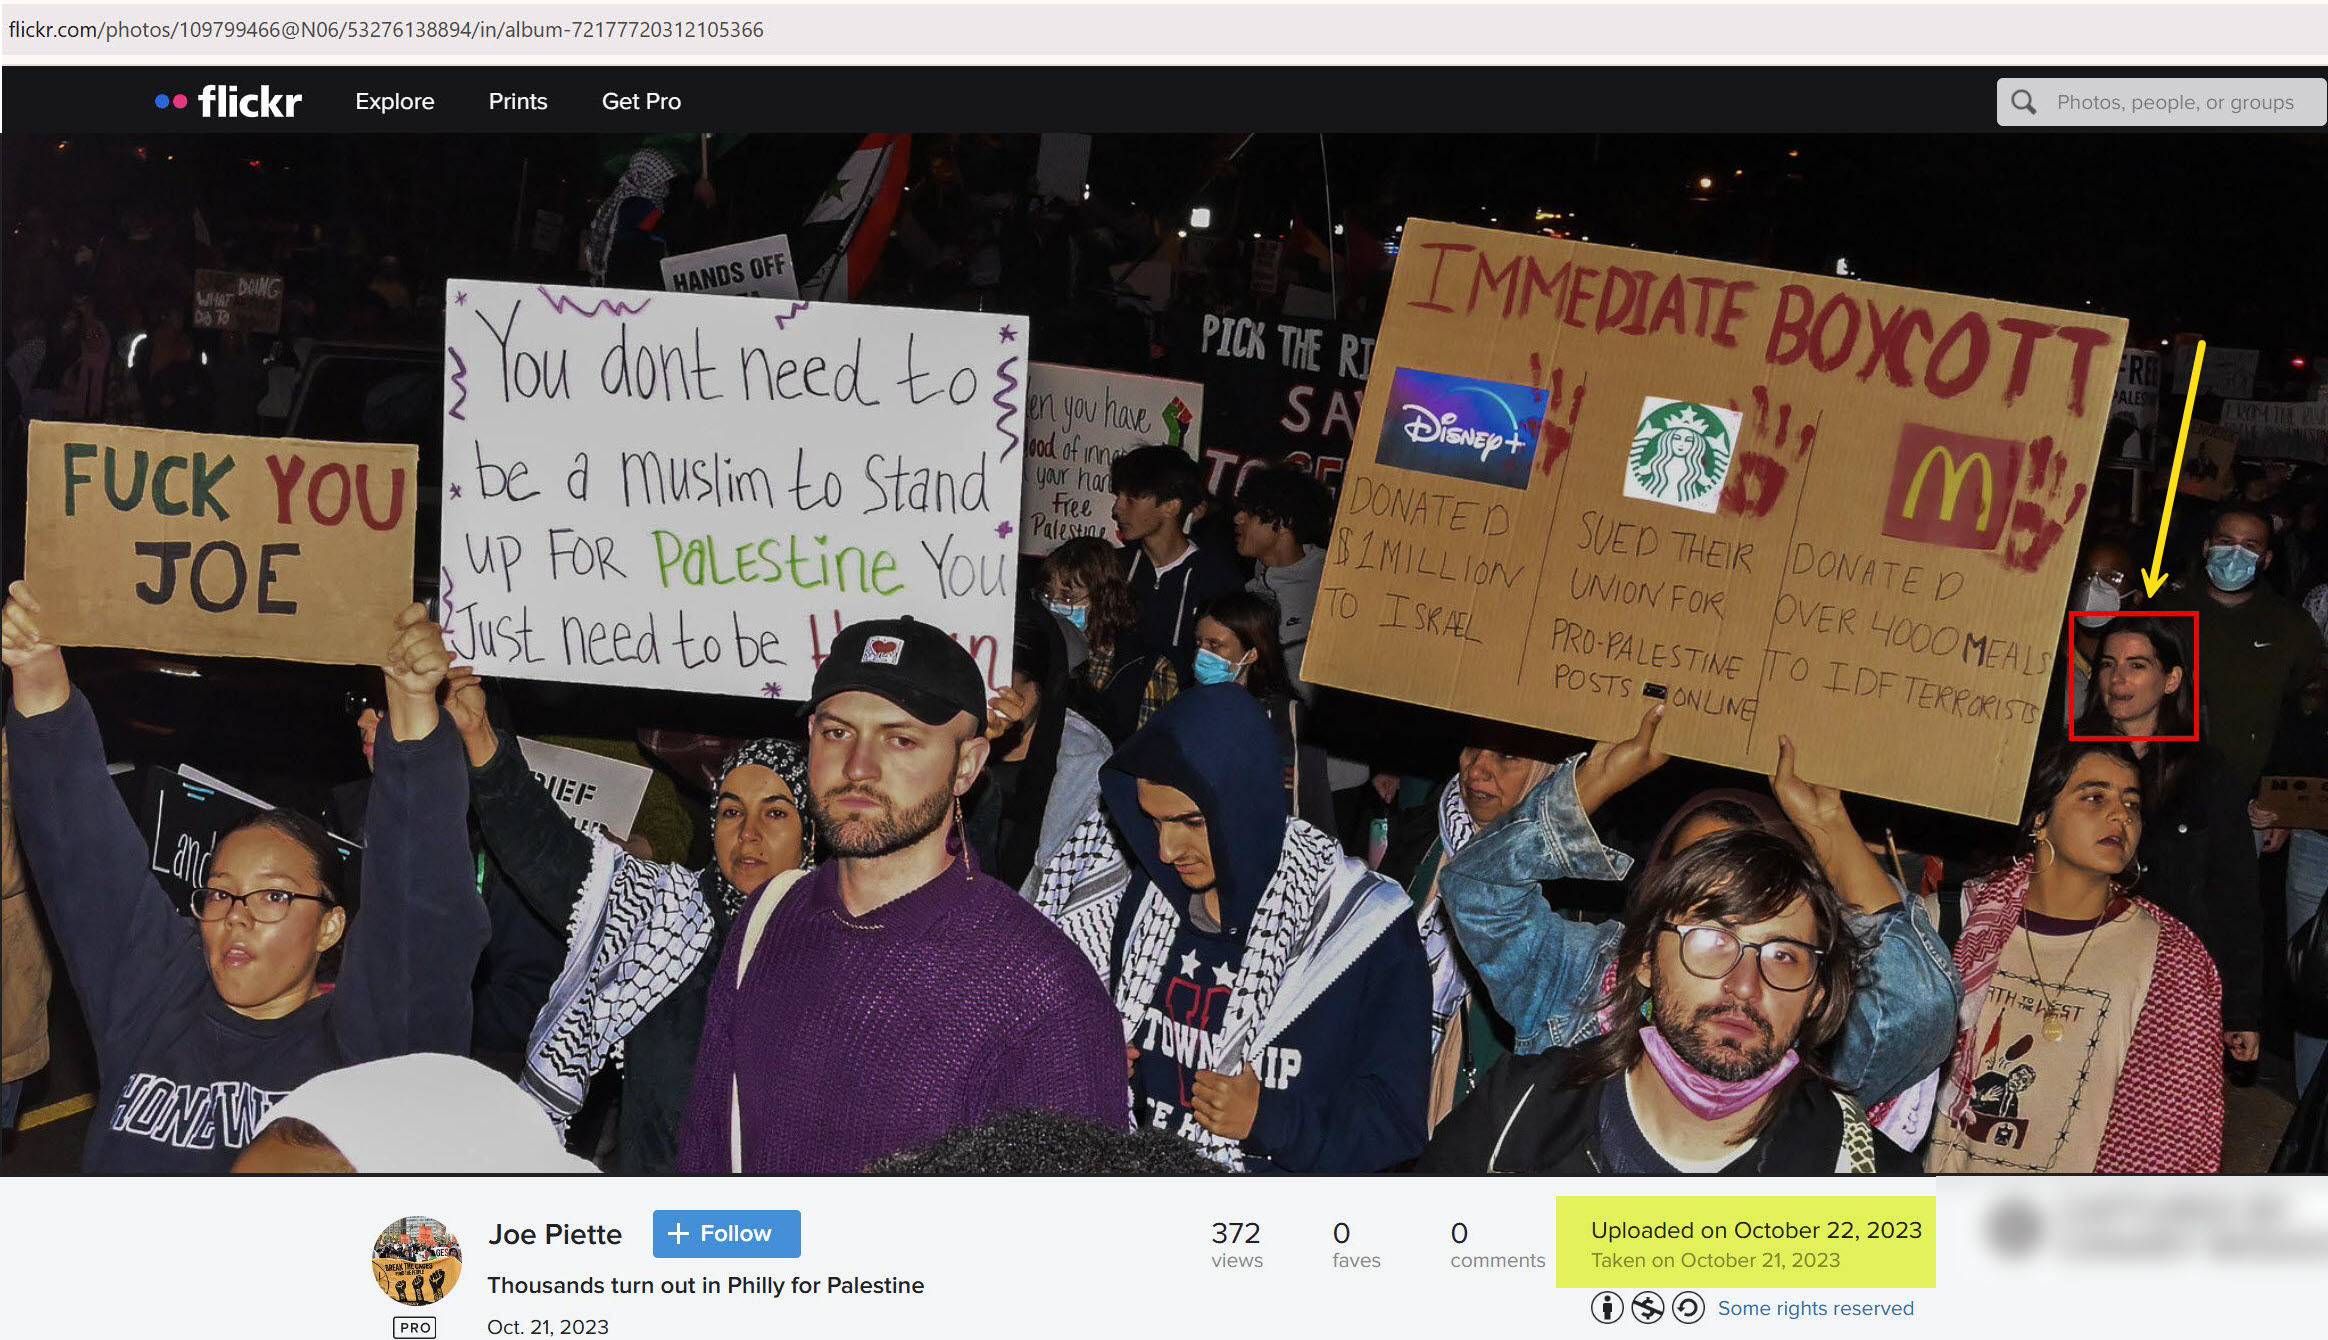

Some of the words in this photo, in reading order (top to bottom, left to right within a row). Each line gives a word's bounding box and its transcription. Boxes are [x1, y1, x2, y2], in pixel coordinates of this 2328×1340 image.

[9, 20, 764, 43] flickr.com/photos/109799466@N06/53276138894/in/album-72177720312105366
[197, 84, 303, 118] flickr
[356, 92, 435, 115] Explore
[489, 92, 548, 111] Prints
[602, 92, 639, 111] Get
[646, 92, 682, 111] Pro
[2058, 94, 2125, 112] Photos,
[2132, 94, 2200, 114] people,
[2206, 97, 2225, 110] or
[2230, 97, 2294, 114] groups
[672, 261, 745, 292] HANDS
[749, 252, 785, 279] OFF
[1202, 313, 1266, 360] PICK
[1277, 323, 1324, 374] THE
[1407, 241, 1759, 347] IMMEDIATE
[1765, 284, 2112, 418] BOYCOTT
[474, 299, 570, 403] You
[601, 322, 724, 403] dont
[740, 337, 880, 406] need
[896, 332, 977, 405] to
[1062, 395, 1098, 435] you
[1104, 385, 1152, 434] have
[1062, 434, 1081, 462] of
[64, 442, 236, 521] FUCK
[265, 452, 405, 532] YOU
[475, 439, 541, 502] be
[566, 451, 589, 501] a
[787, 447, 843, 512] to
[1052, 491, 1093, 518] Free
[1349, 475, 1510, 536] DONATED
[1031, 511, 1106, 541] Palestine
[1577, 510, 1659, 557] SUED
[1671, 530, 1754, 574] THEIR
[134, 539, 301, 615] JOE
[548, 527, 627, 581] FOR
[921, 532, 1011, 600] You
[1792, 541, 1965, 602] DONATED
[1570, 566, 1665, 608] UNION
[1670, 584, 1727, 621] FOR
[1323, 587, 1359, 619] TO
[1378, 591, 1483, 645] ISRAEL
[450, 601, 546, 664] Just
[560, 613, 660, 666] need
[677, 609, 722, 670] to
[733, 610, 788, 668] be
[1551, 617, 1745, 681] PRO-PALESTINE
[1773, 593, 1857, 635] OVER
[1870, 610, 1961, 656] 4000
[1961, 631, 2052, 677] MEALS
[1554, 663, 1633, 698] POSTS
[1764, 648, 1810, 682] TO
[1821, 660, 1899, 699] IDF
[1904, 674, 2041, 725] TERRORISTS
[488, 1223, 537, 1246] Joe
[545, 1223, 623, 1246] Piette
[701, 1223, 773, 1243] Follow
[1212, 1222, 1260, 1244] 372
[1333, 1222, 1351, 1245] 0
[1451, 1222, 1469, 1245] 0
[1592, 1221, 1694, 1244] Uploaded
[1700, 1225, 1729, 1239] on
[1734, 1221, 1821, 1239] October
[1827, 1221, 1861, 1242] 22,
[1867, 1221, 1922, 1239] 2023
[1211, 1252, 1264, 1268] views
[1332, 1252, 1381, 1268] faves
[1450, 1254, 1546, 1270] comments
[1591, 1252, 1646, 1268] Taken
[1651, 1255, 1675, 1268] on
[1681, 1252, 1757, 1268] October
[1762, 1252, 1786, 1271] 21,
[1792, 1252, 1841, 1268] 2023
[486, 1276, 605, 1294] Thousands
[610, 1277, 654, 1294] turn
[660, 1277, 696, 1294] out
[702, 1276, 721, 1294] in
[728, 1276, 786, 1299] Philly
[790, 1276, 822, 1294] for
[827, 1276, 925, 1294] Palestine
[1718, 1300, 1771, 1316] Some
[1777, 1300, 1828, 1320] rights
[1833, 1301, 1915, 1316] reserved
[400, 1322, 431, 1334] PRO
[487, 1319, 525, 1335] Oct.
[530, 1319, 554, 1338] 21,
[559, 1319, 609, 1335] 2023
